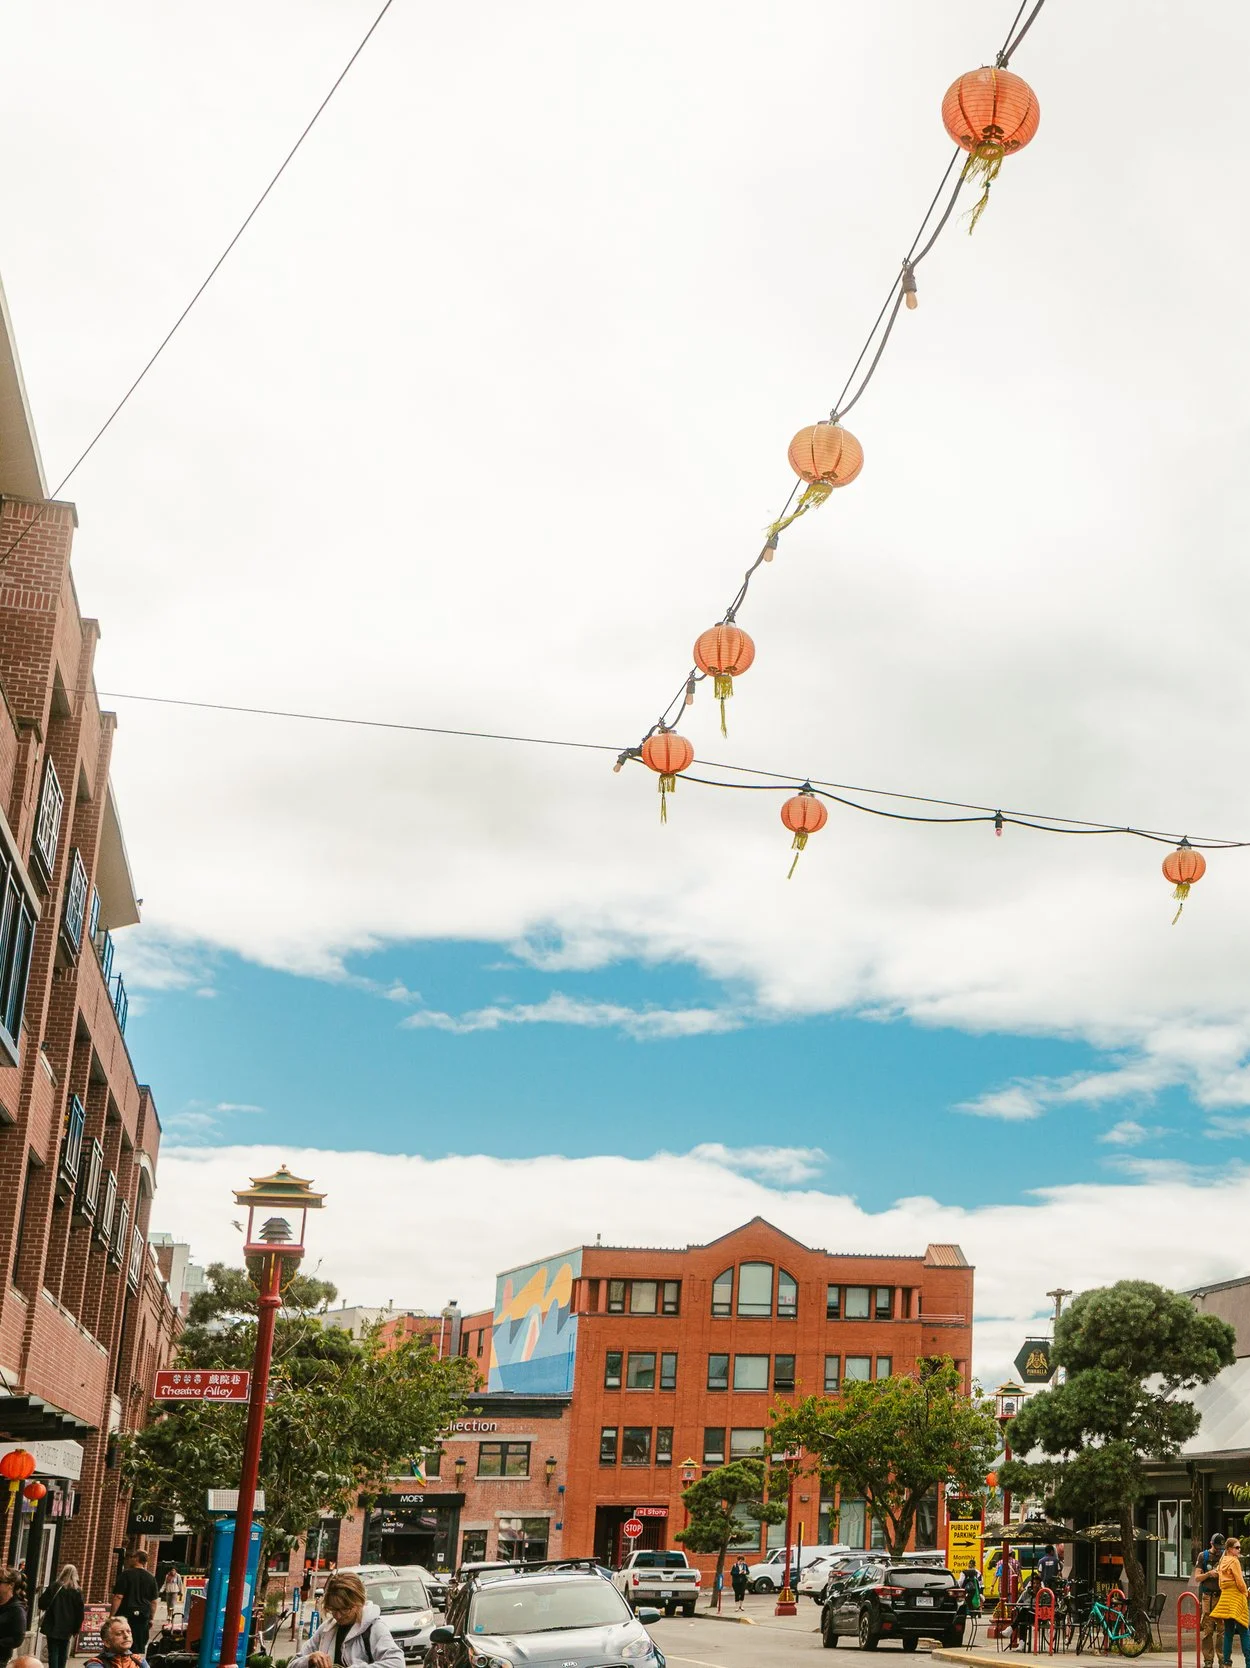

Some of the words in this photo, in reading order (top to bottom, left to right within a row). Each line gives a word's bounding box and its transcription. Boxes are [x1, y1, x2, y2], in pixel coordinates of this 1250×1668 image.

[161, 1385, 201, 1395] Theatre
[203, 1385, 233, 1398] Alley
[400, 1494, 424, 1503] MOE'S
[625, 1524, 642, 1532] STOP
[954, 1531, 976, 1539] PARKING
